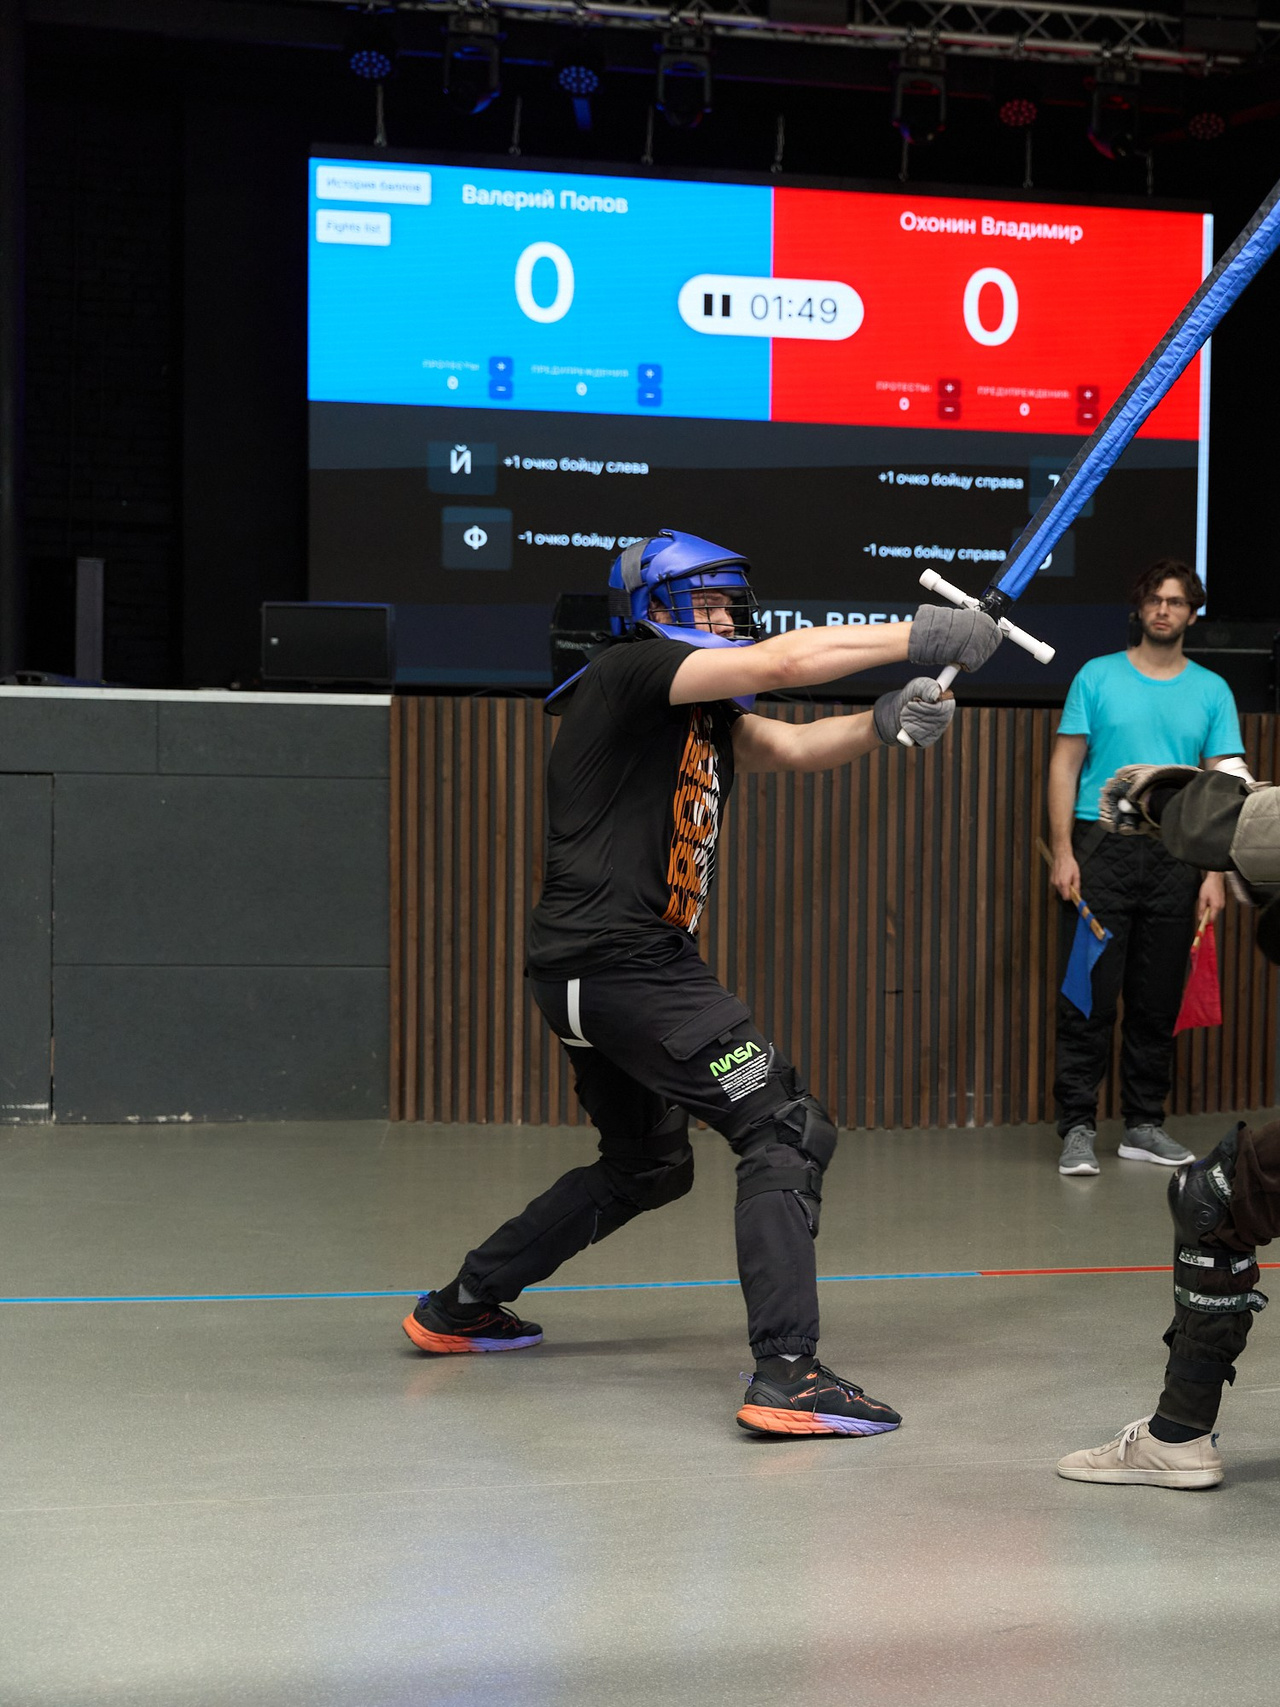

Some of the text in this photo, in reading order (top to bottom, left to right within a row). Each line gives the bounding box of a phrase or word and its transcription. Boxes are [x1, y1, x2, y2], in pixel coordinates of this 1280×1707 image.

[461, 185, 629, 214] Валерий Попов
[899, 210, 1084, 244] Охонин Владимир
[514, 240, 576, 324] 0
[750, 293, 838, 324] 01:49
[962, 266, 1019, 347] 0
[449, 444, 472, 475] Й
[503, 454, 650, 476] +1 очко бойцу слева
[878, 470, 1025, 491] +1 очко бойцу справа
[462, 525, 489, 551] Ф
[518, 530, 533, 546] -1
[534, 532, 570, 547] очко
[571, 532, 617, 551] бойцу
[862, 542, 1008, 563] -1 очко бойцу справа
[709, 1041, 762, 1077] NASA
[1189, 1291, 1237, 1306] VEMAR
